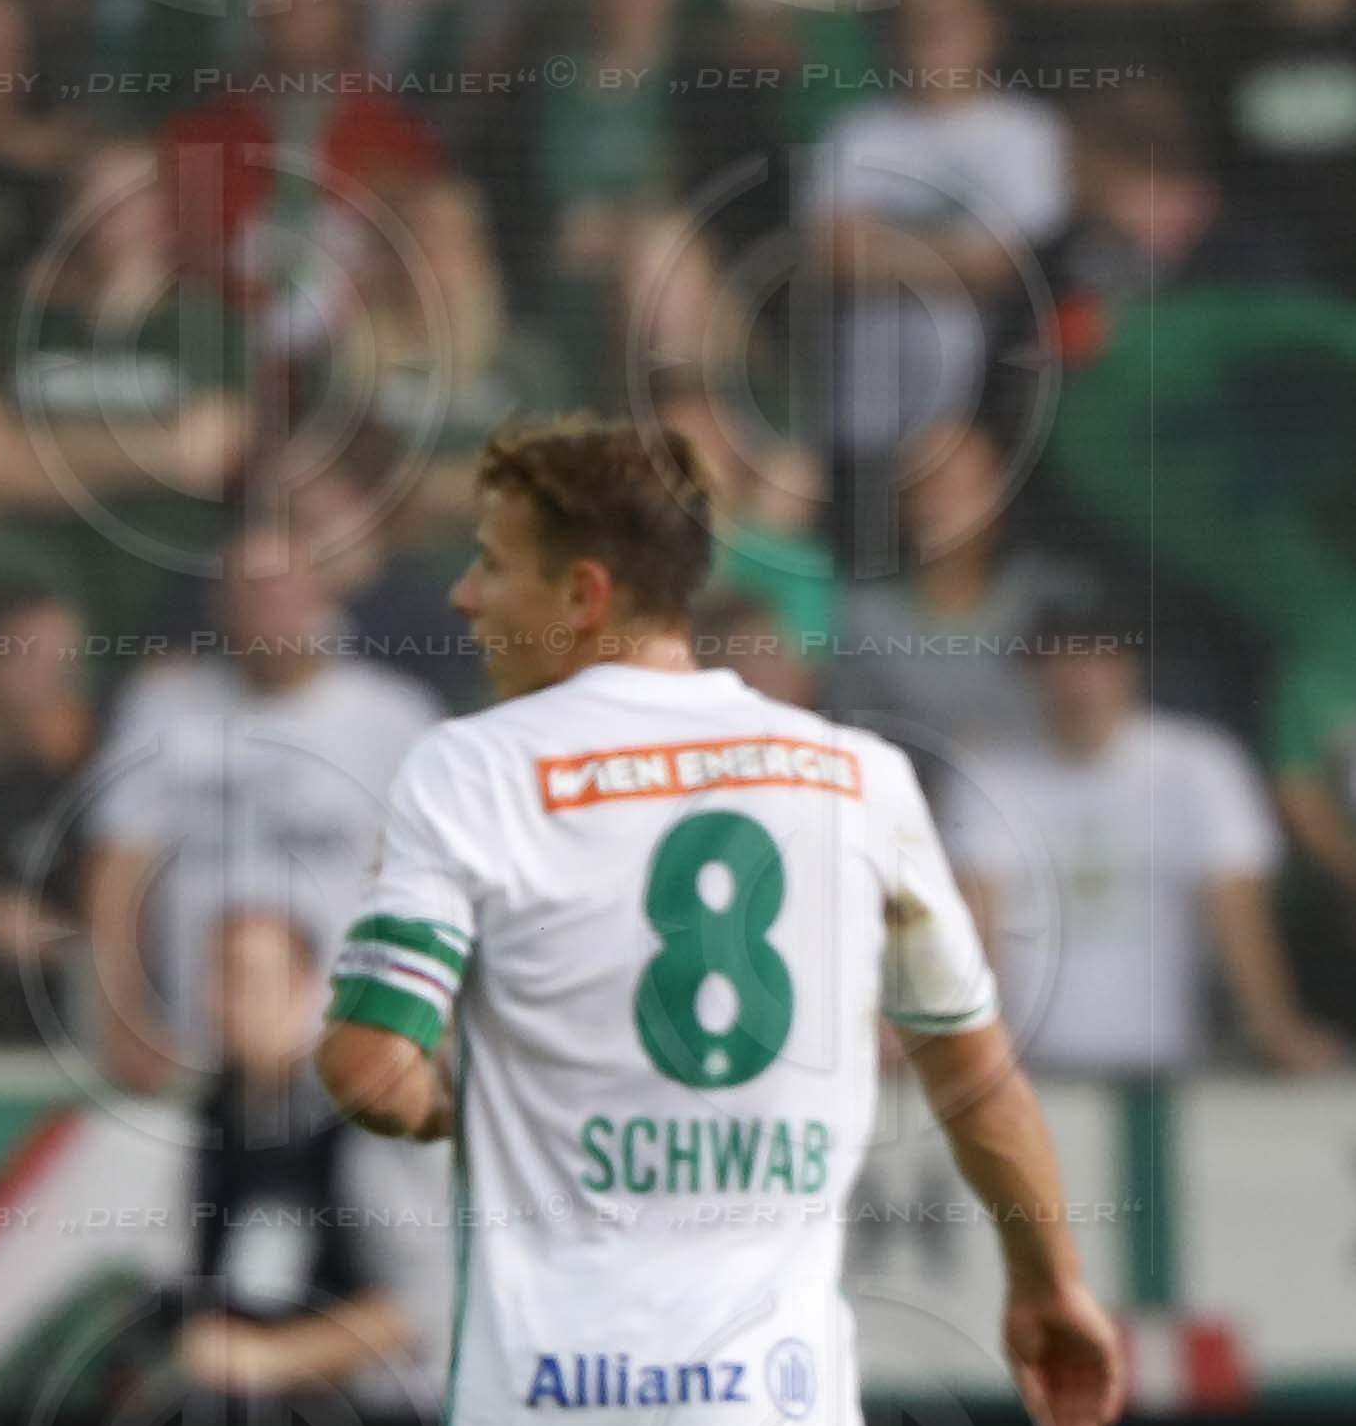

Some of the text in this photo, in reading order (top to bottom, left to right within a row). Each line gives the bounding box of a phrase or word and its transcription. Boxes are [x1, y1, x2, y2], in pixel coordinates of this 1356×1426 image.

[549, 754, 668, 801] WIEN
[633, 808, 796, 1091] 8
[579, 1115, 833, 1195] SCHWAB
[525, 1352, 750, 1408] Allianz
